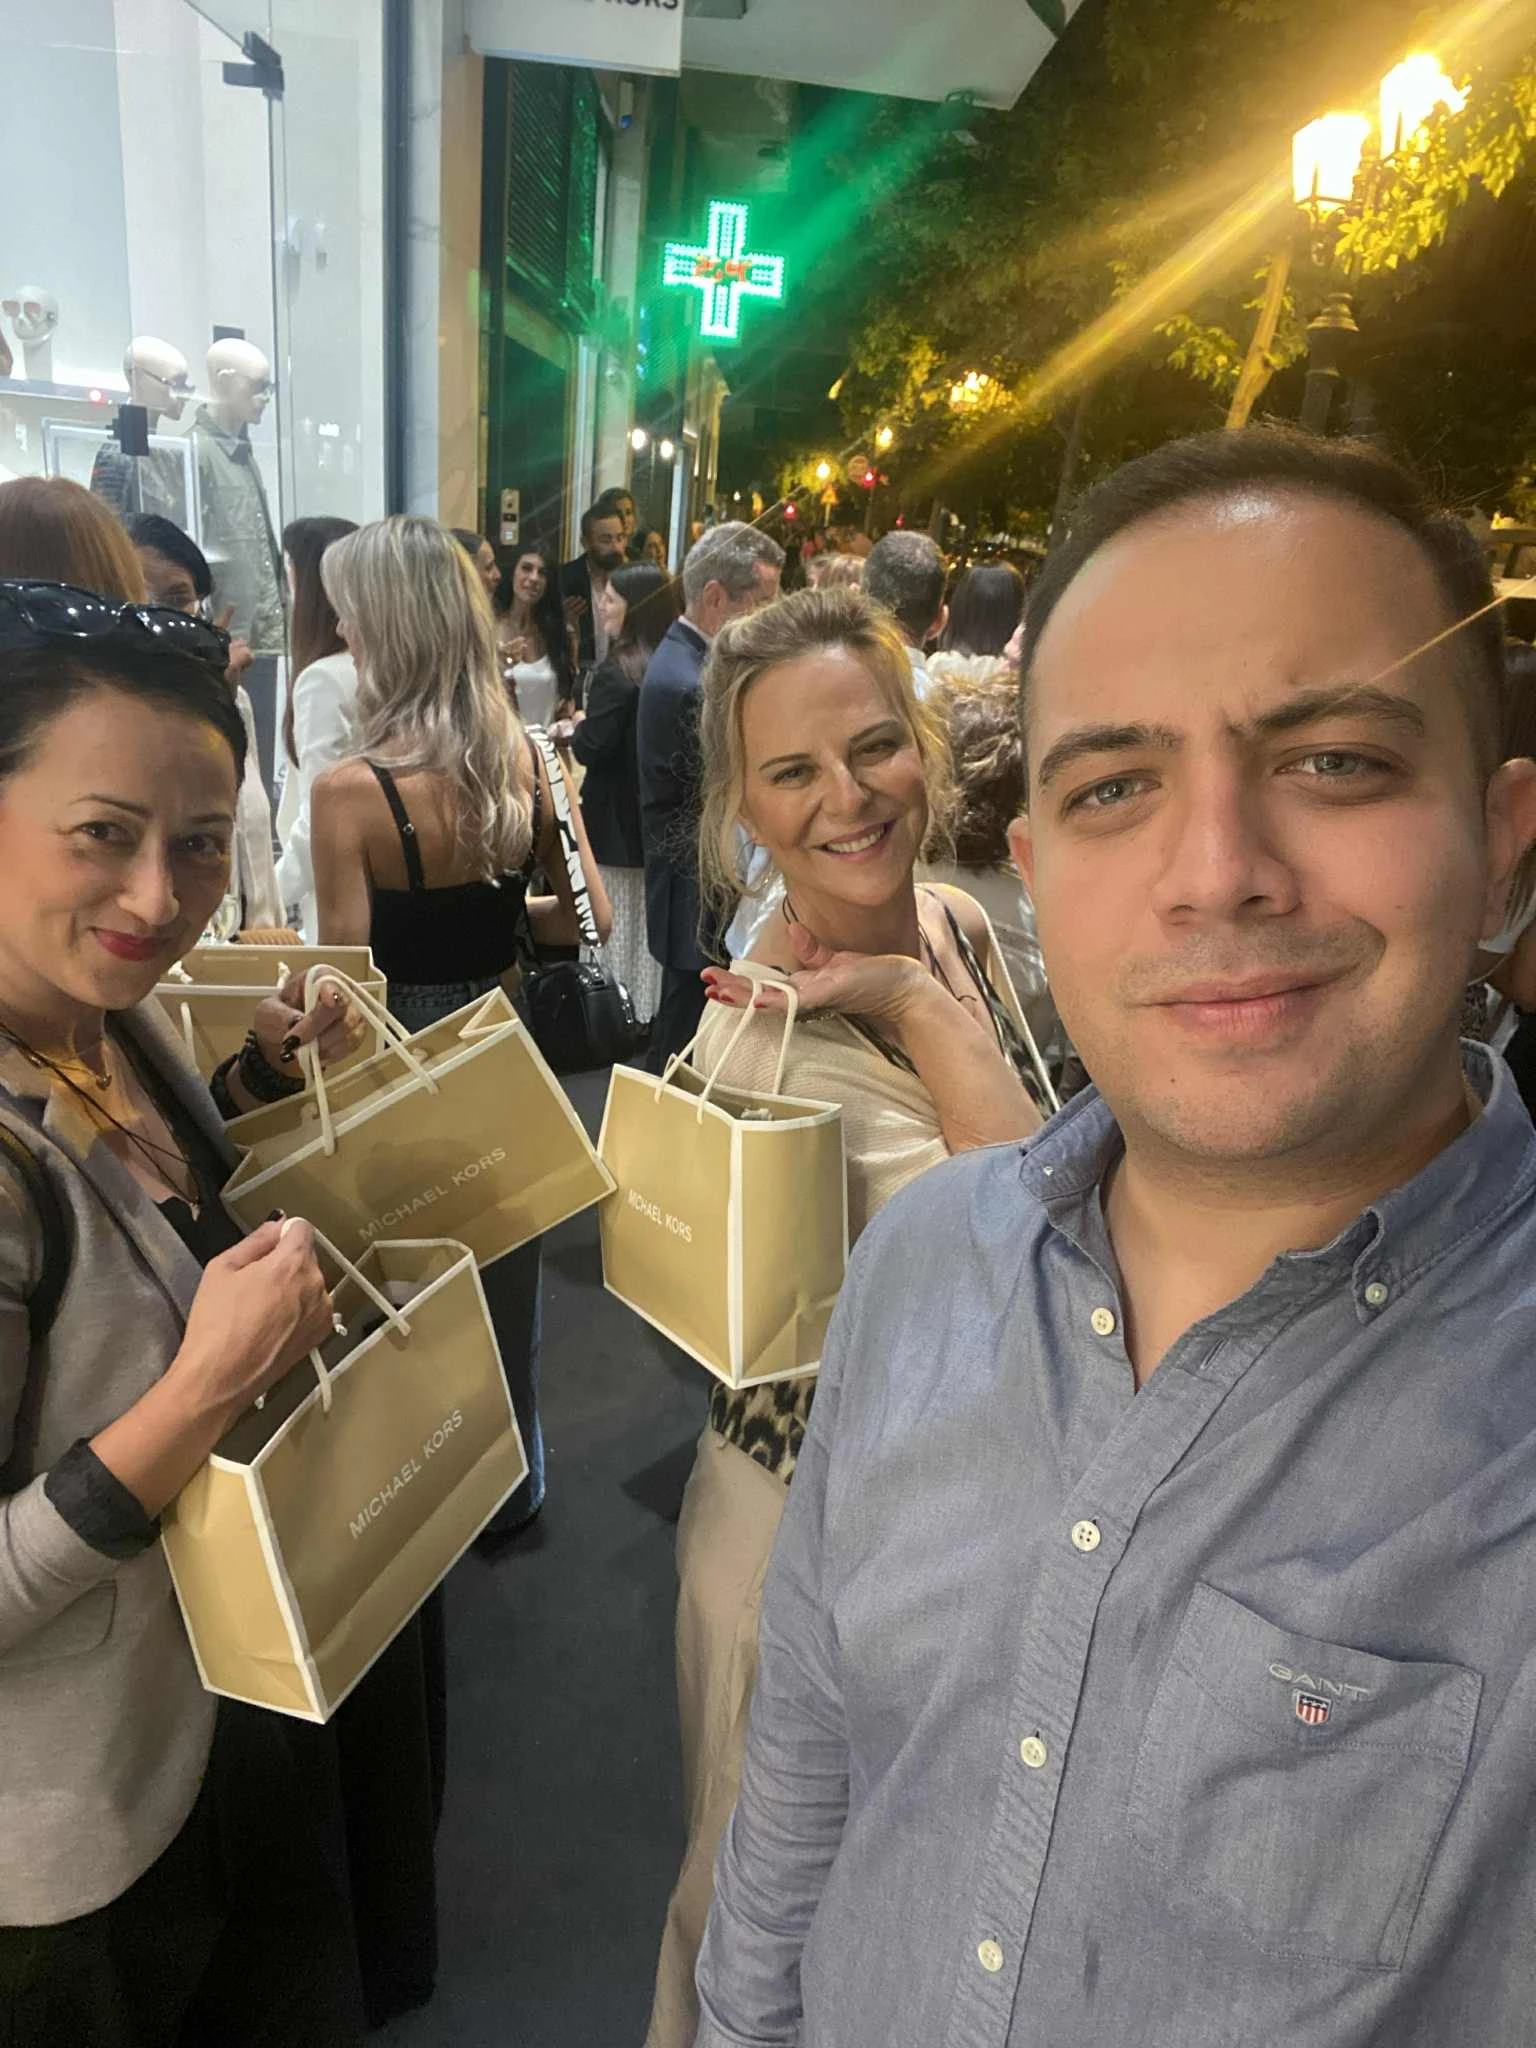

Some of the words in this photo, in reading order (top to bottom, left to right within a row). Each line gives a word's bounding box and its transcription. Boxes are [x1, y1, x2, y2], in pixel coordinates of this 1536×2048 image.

[358, 1184, 449, 1241] MICHAEL
[451, 1147, 507, 1186] KORS
[627, 1188, 663, 1225] MICHAEL
[665, 1213, 692, 1243] KORS
[348, 1458, 422, 1540] MICHAEL
[423, 1408, 463, 1458] KORS
[1268, 1662, 1369, 1702] GANT
